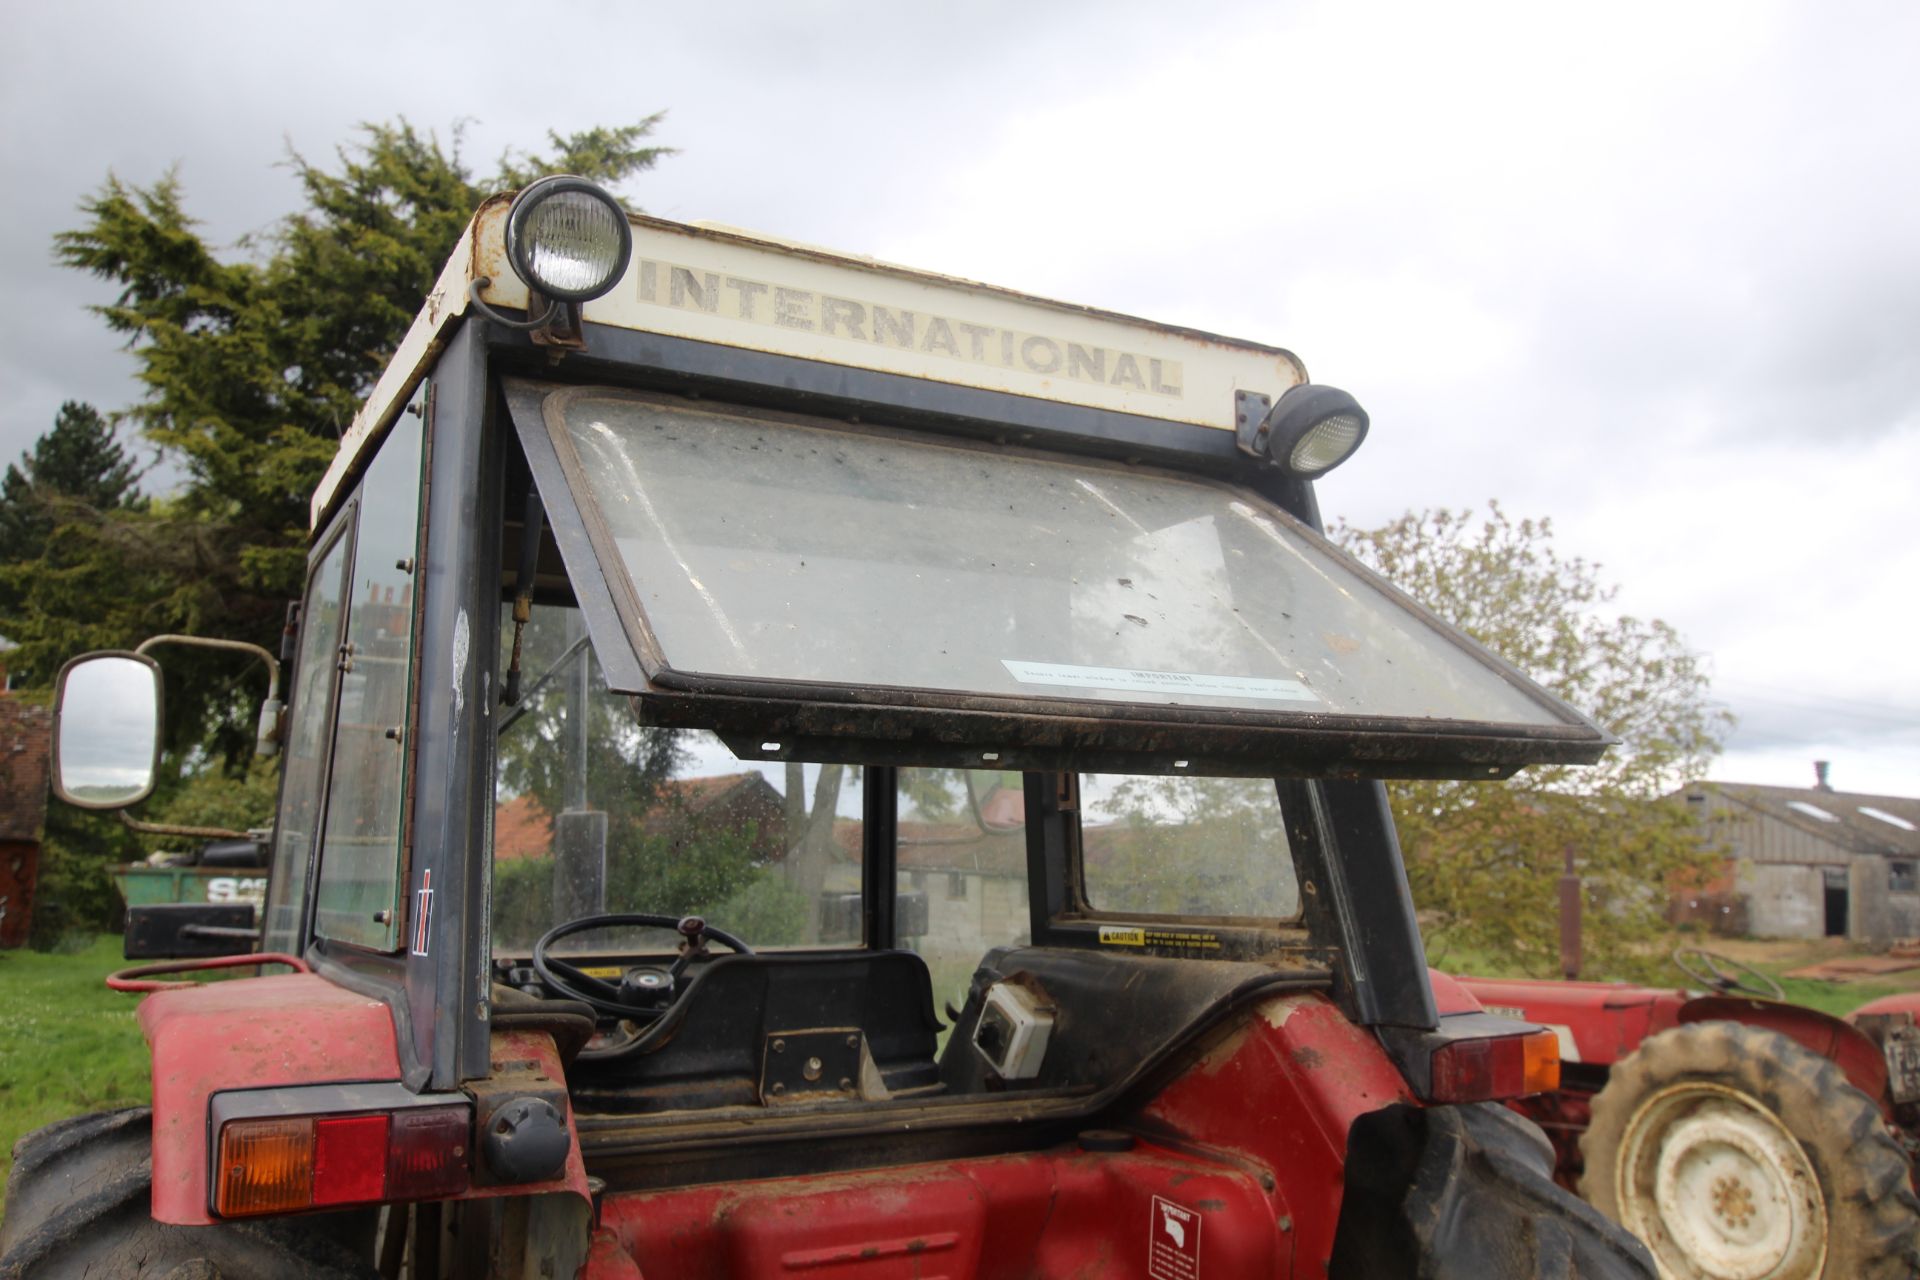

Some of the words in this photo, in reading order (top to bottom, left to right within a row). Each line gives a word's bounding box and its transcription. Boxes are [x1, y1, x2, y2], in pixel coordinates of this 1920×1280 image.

[639, 261, 1181, 396] INTERNATIONAL
[1130, 671, 1193, 682] IMPORTANT
[1111, 931, 1139, 941] CAUTION
